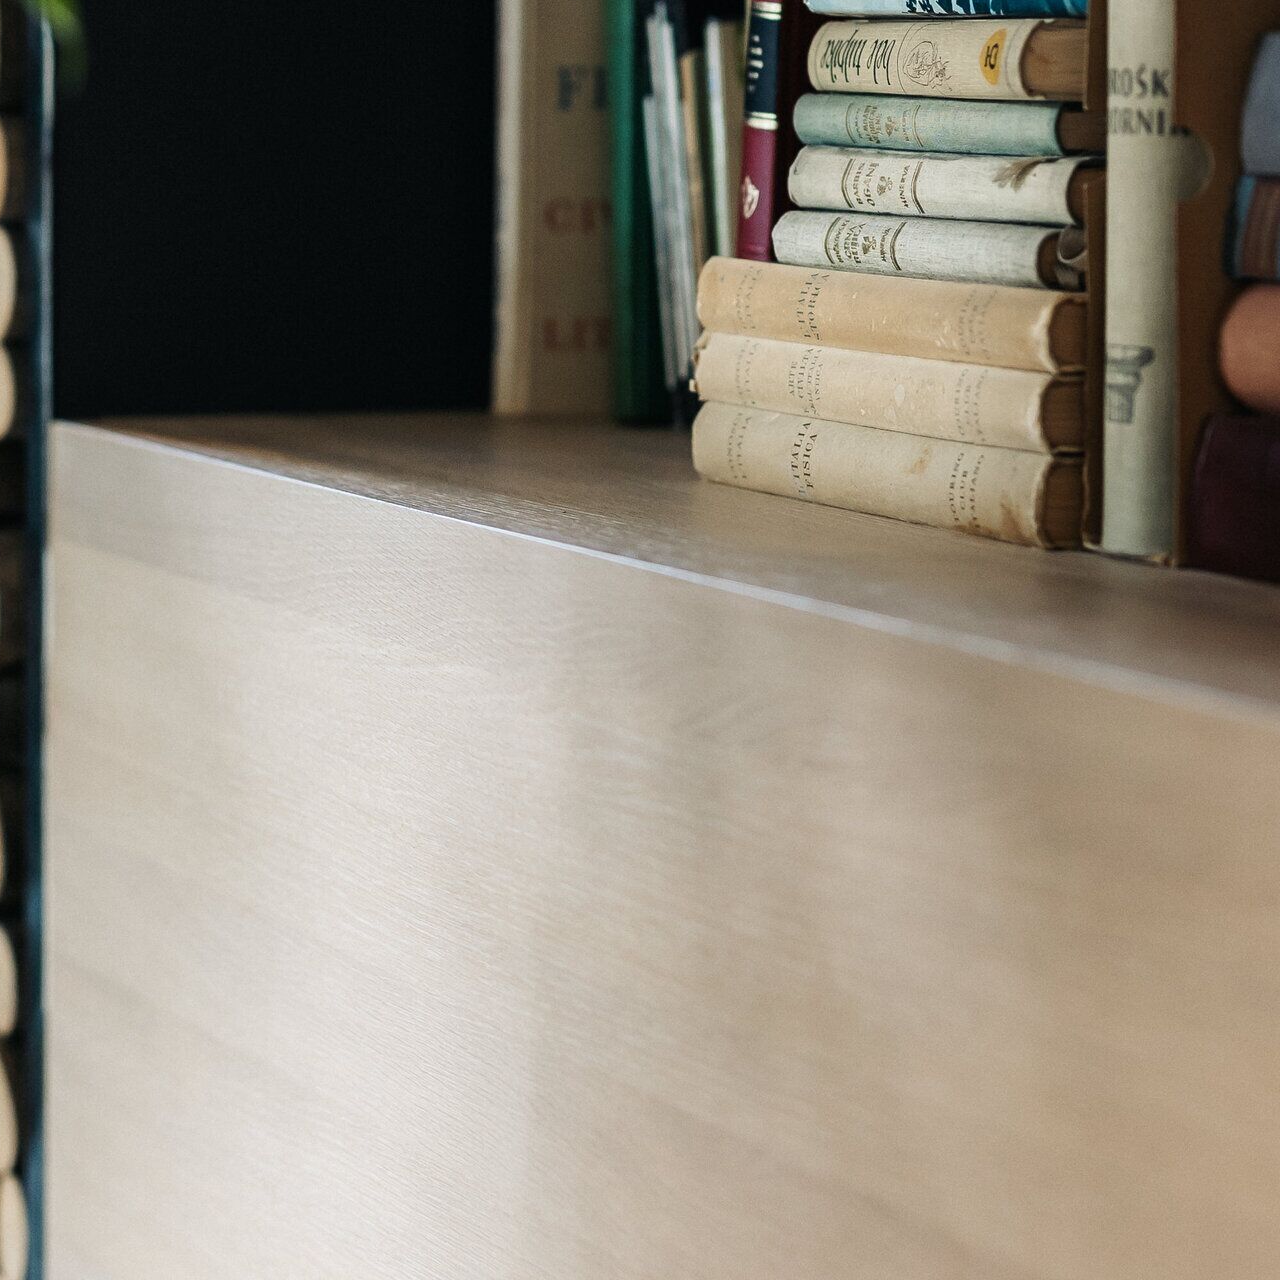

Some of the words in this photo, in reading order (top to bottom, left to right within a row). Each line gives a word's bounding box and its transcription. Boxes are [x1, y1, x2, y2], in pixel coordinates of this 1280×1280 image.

[867, 39, 896, 86] bele
[898, 164, 911, 209] MINERVA
[787, 360, 798, 397] ARTE
[802, 433, 818, 489] FISICA
